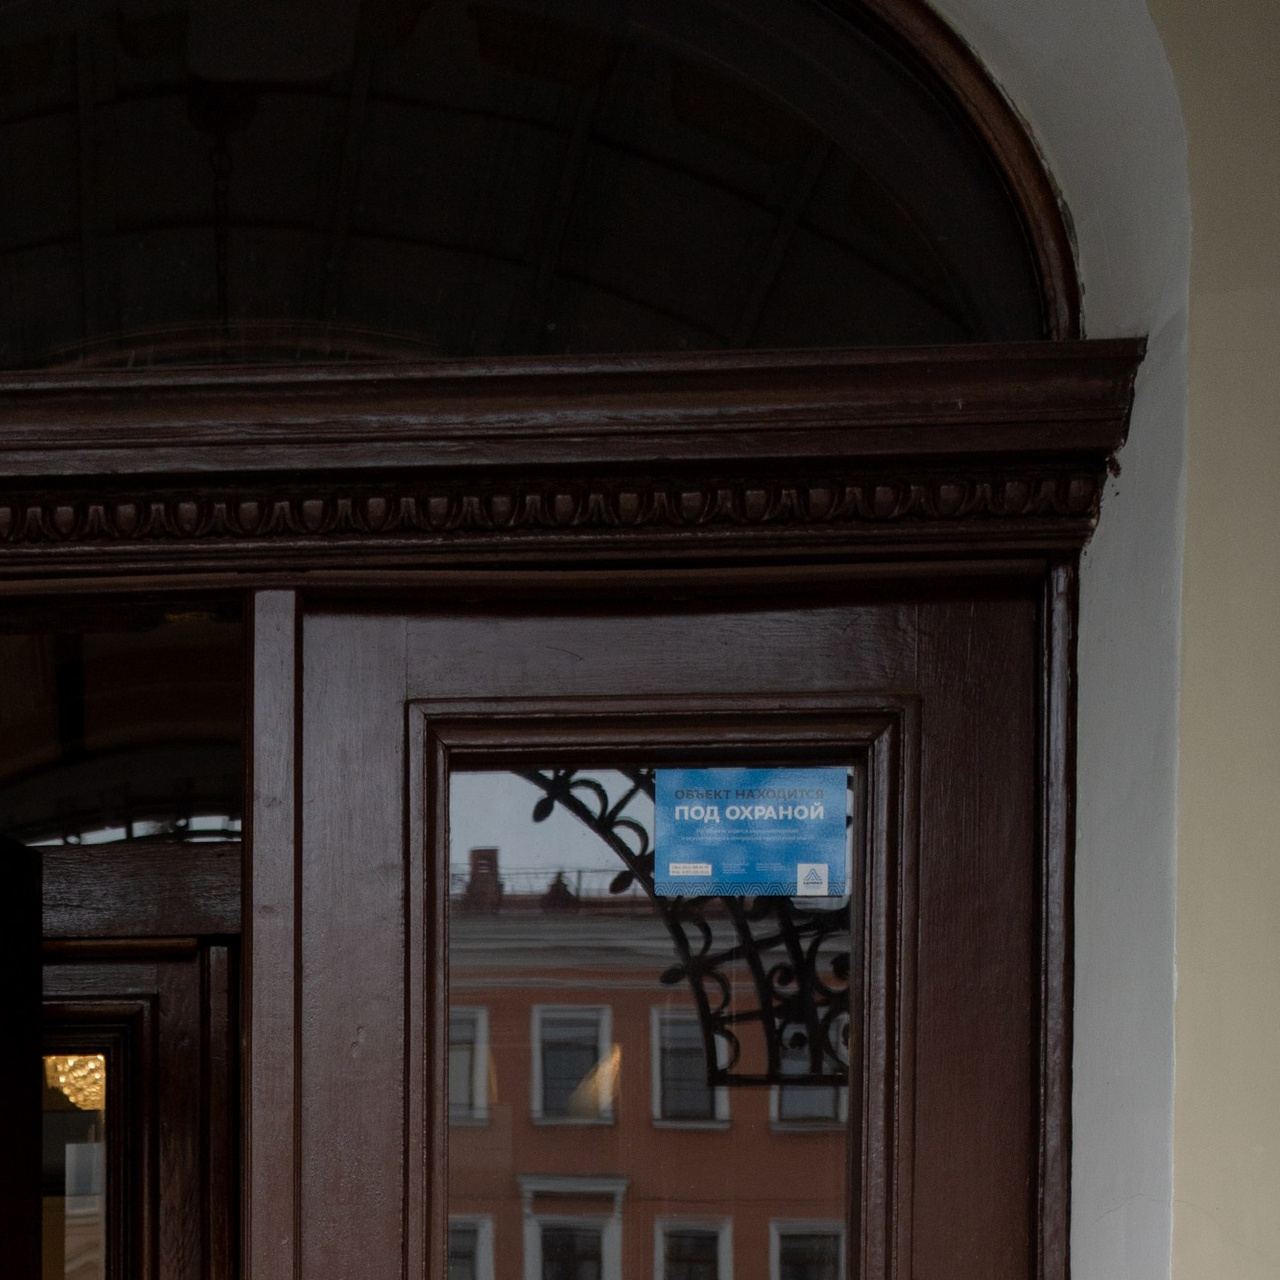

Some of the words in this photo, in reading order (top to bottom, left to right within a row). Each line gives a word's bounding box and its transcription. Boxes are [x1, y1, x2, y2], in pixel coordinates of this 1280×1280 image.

[674, 789, 730, 800] ОБЪЕКТ
[735, 788, 824, 801] НАХОДИТСЯ
[674, 805, 720, 824] ПОД
[725, 802, 825, 820] ОХРАНОЙ
